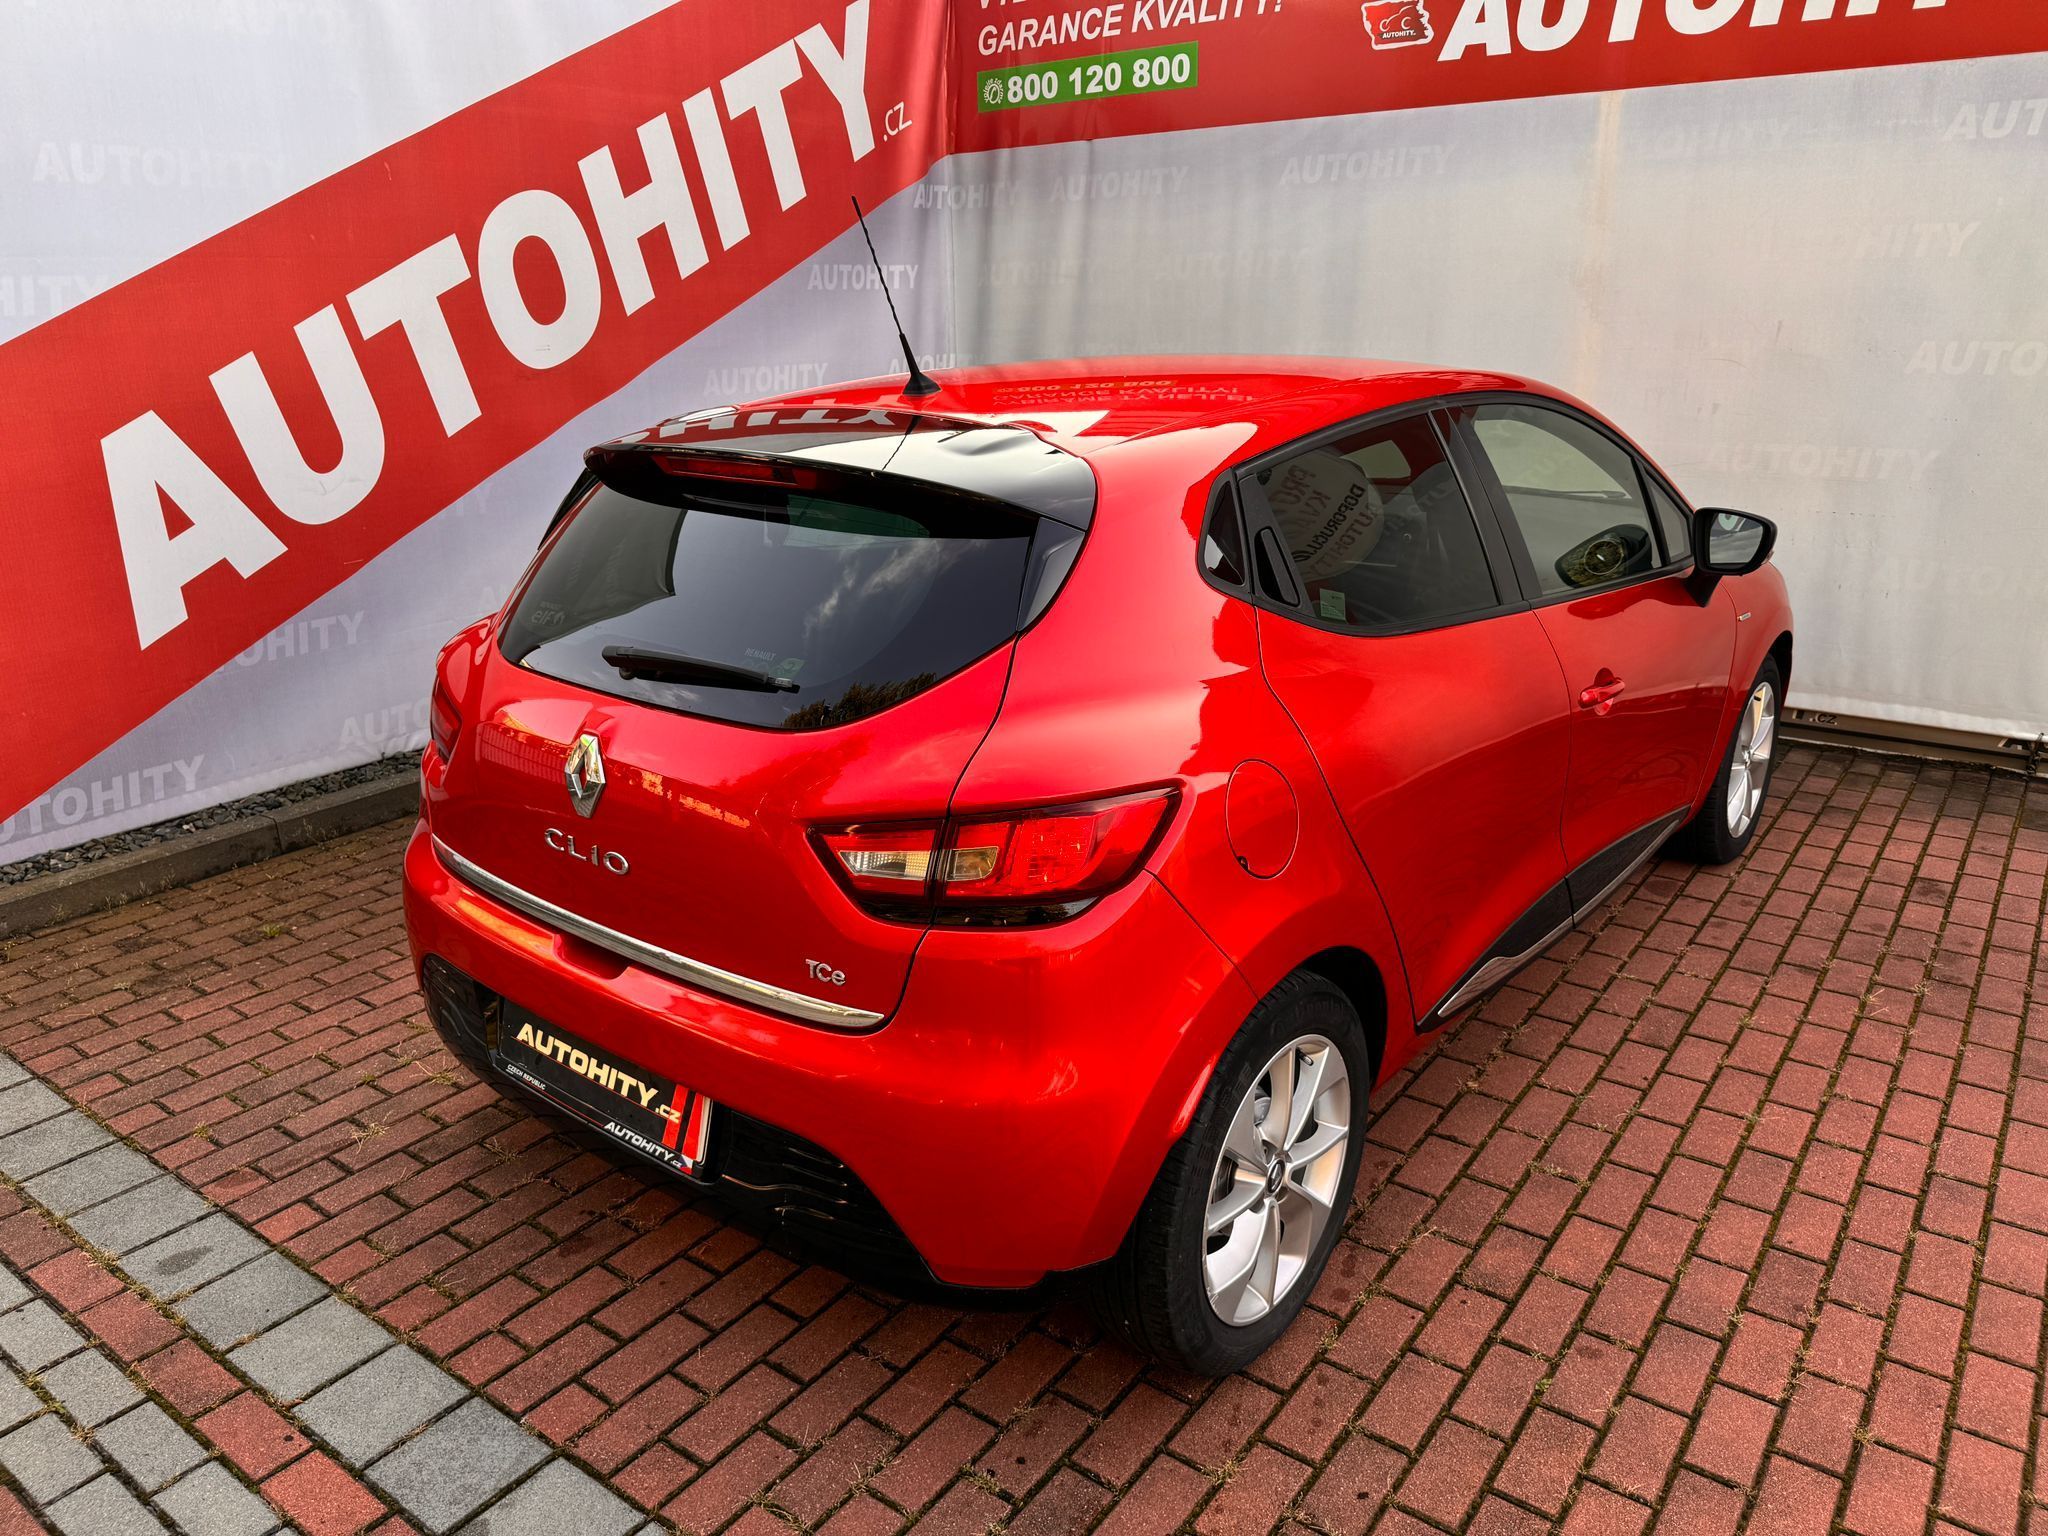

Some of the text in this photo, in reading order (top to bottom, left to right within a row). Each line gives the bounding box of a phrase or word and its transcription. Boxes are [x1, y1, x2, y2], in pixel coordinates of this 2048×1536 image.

[978, 3, 1124, 56] GARANCE
[1007, 53, 1191, 104] 800 120 800
[544, 827, 629, 875] CLIO
[805, 958, 846, 986] TCe
[507, 1063, 547, 1090] CZECH REPUBLIC
